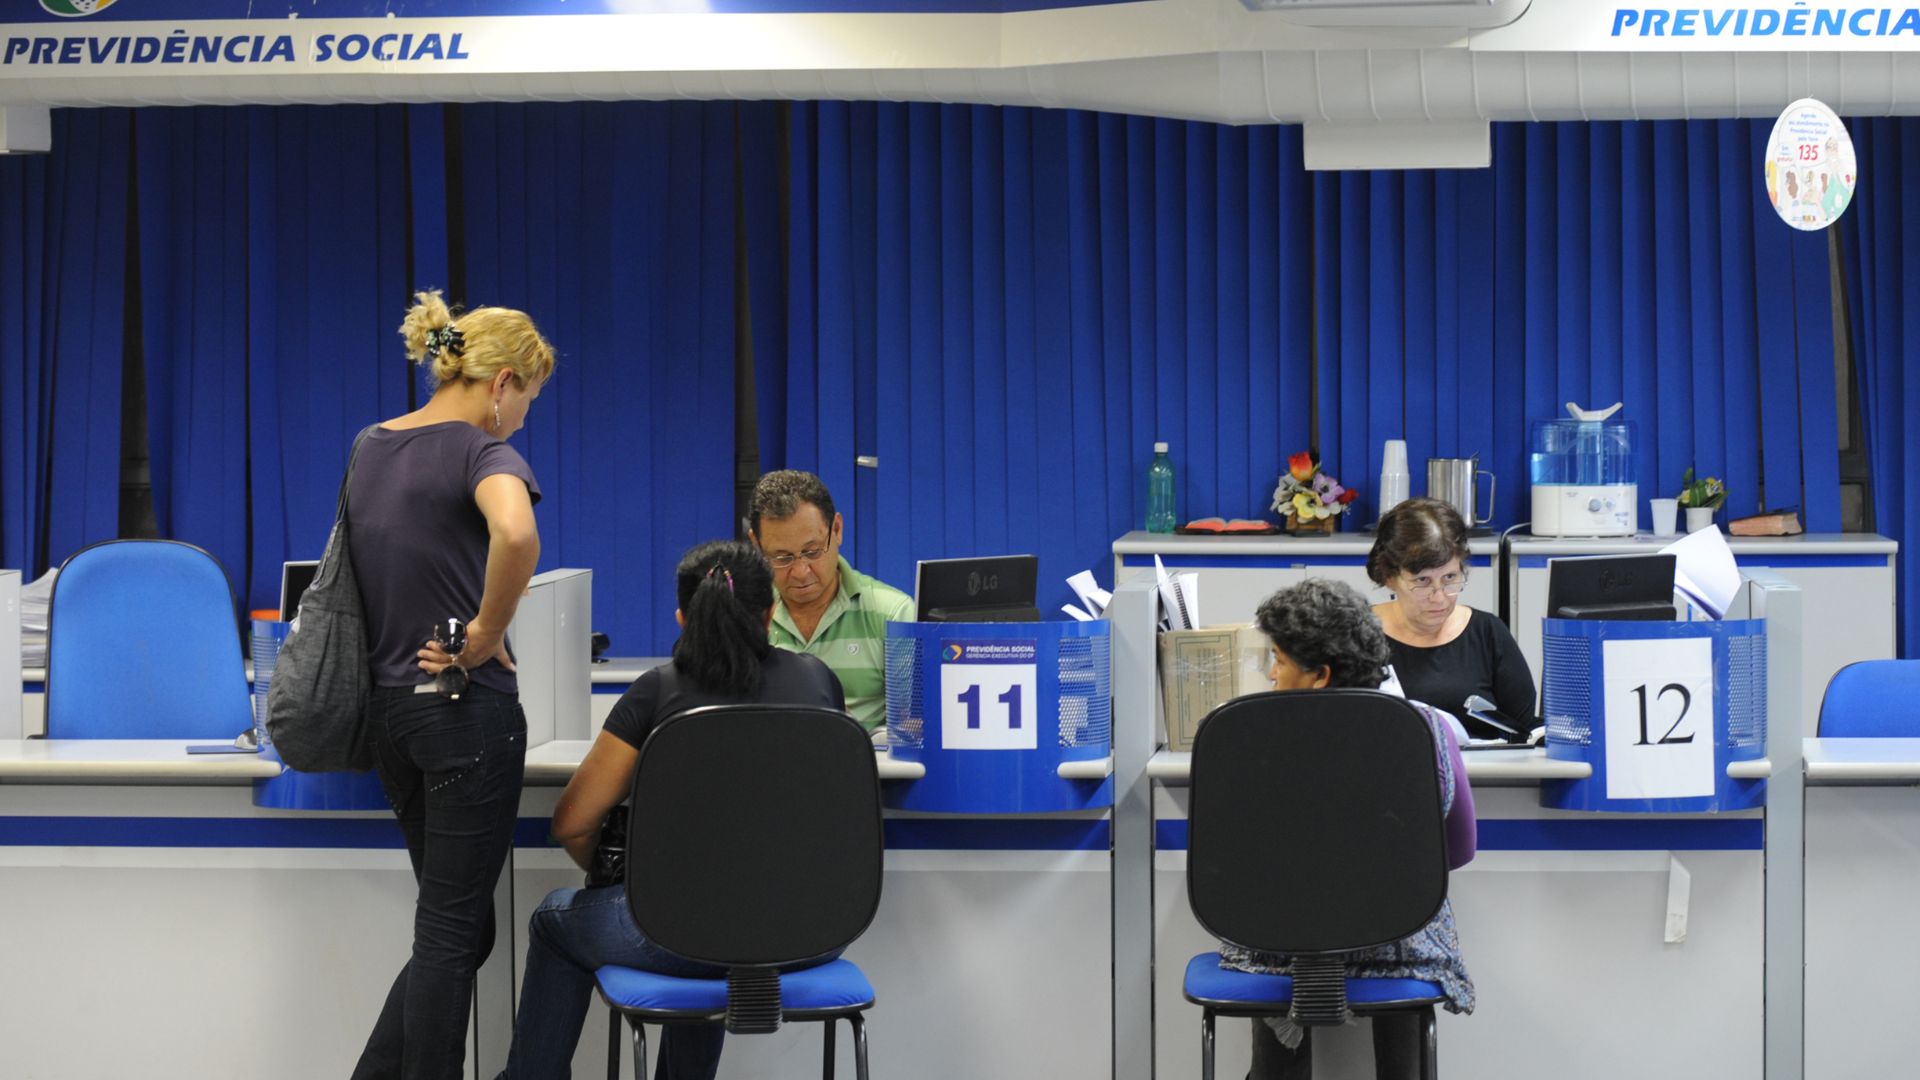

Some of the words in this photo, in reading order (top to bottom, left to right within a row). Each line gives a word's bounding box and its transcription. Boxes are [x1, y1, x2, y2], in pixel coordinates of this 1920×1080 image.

[1611, 2, 1920, 36] PREVIDÊNCIA
[3, 30, 296, 64] PREVIDÊNCIA
[316, 33, 469, 61] SOCIAL
[1798, 144, 1819, 161] 135
[983, 575, 998, 590] LG
[957, 684, 1022, 729] 11
[1630, 683, 1696, 746] 12
